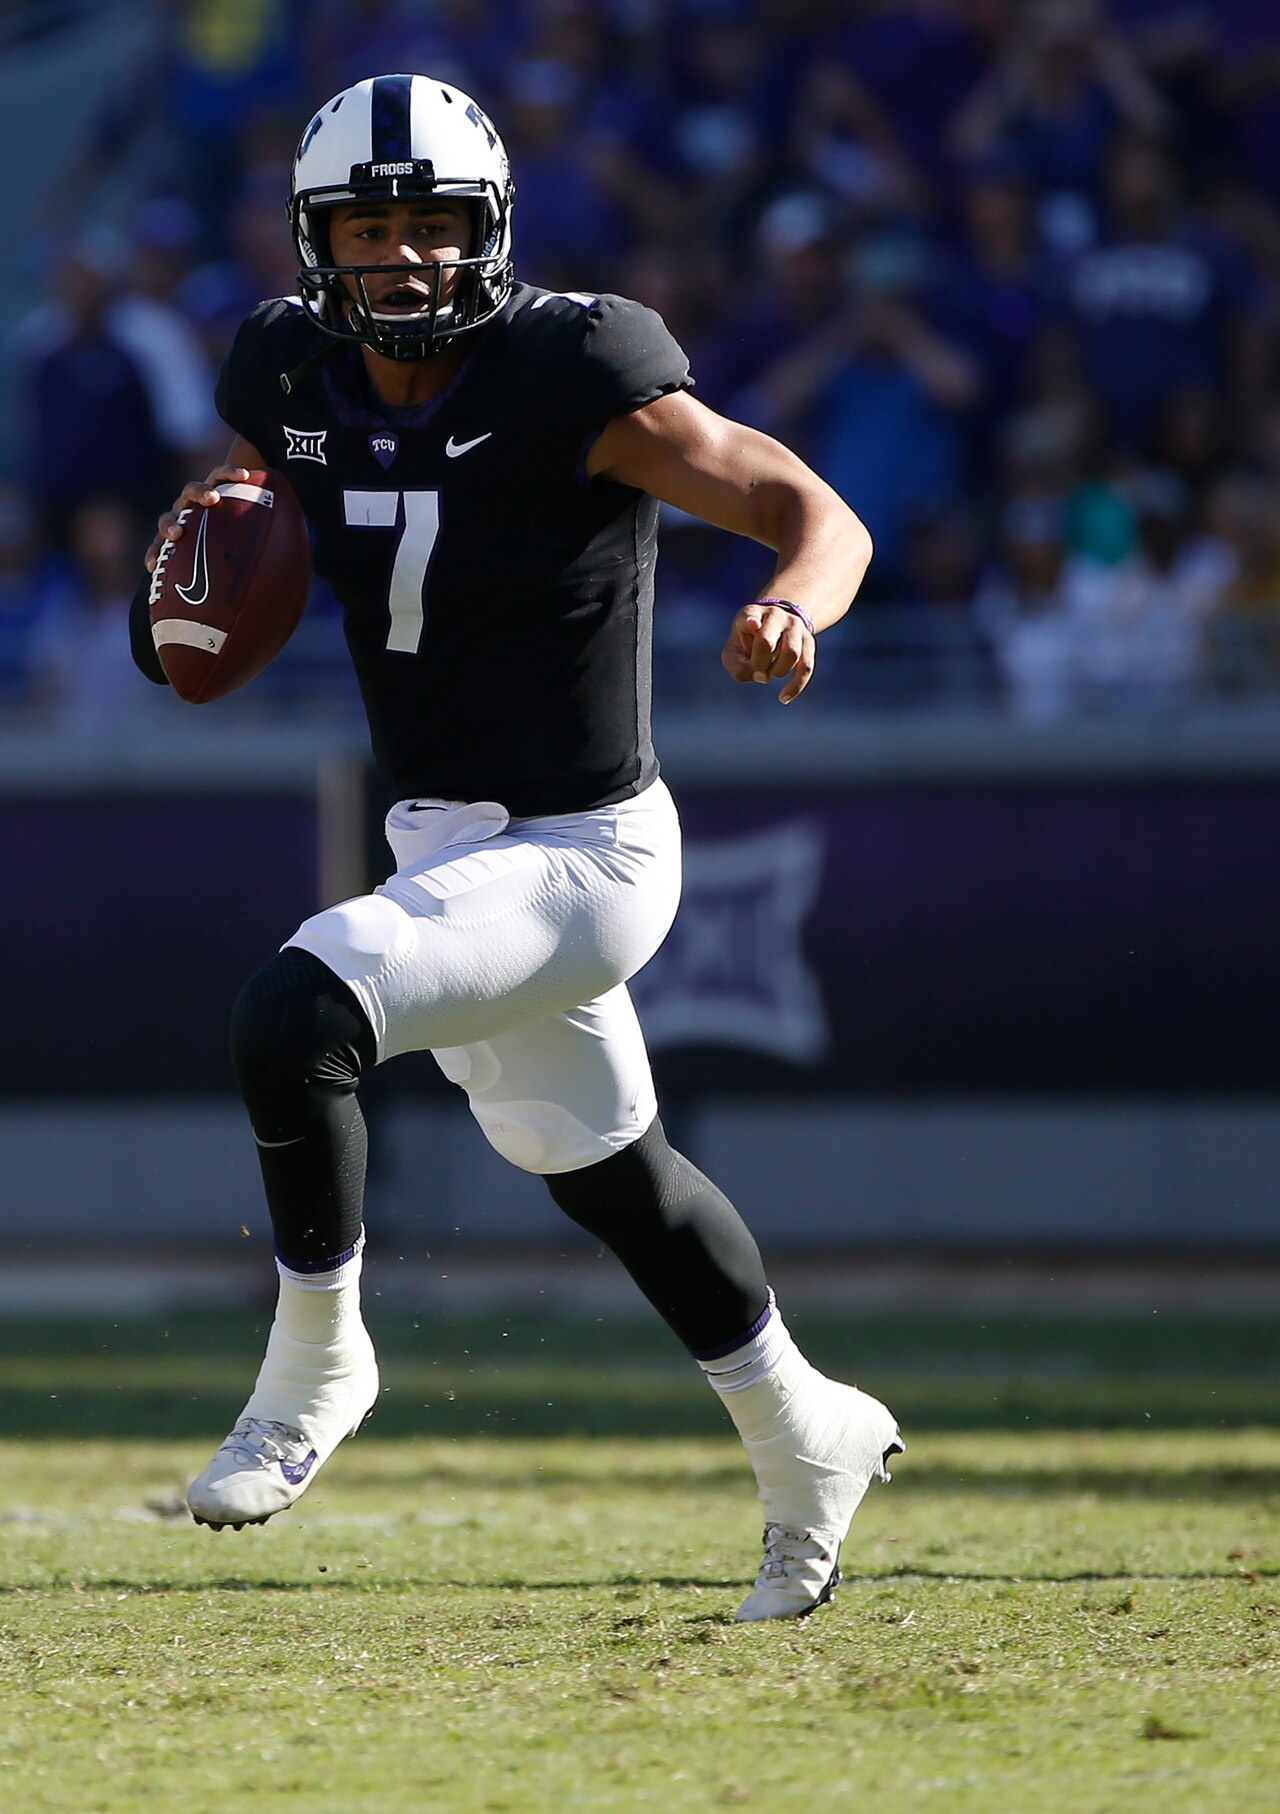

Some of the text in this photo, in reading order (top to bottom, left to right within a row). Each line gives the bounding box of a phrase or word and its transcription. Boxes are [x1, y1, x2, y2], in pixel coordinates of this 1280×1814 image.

[371, 162, 414, 178] FROGS
[372, 438, 396, 453] TCU
[342, 489, 440, 654] 7
